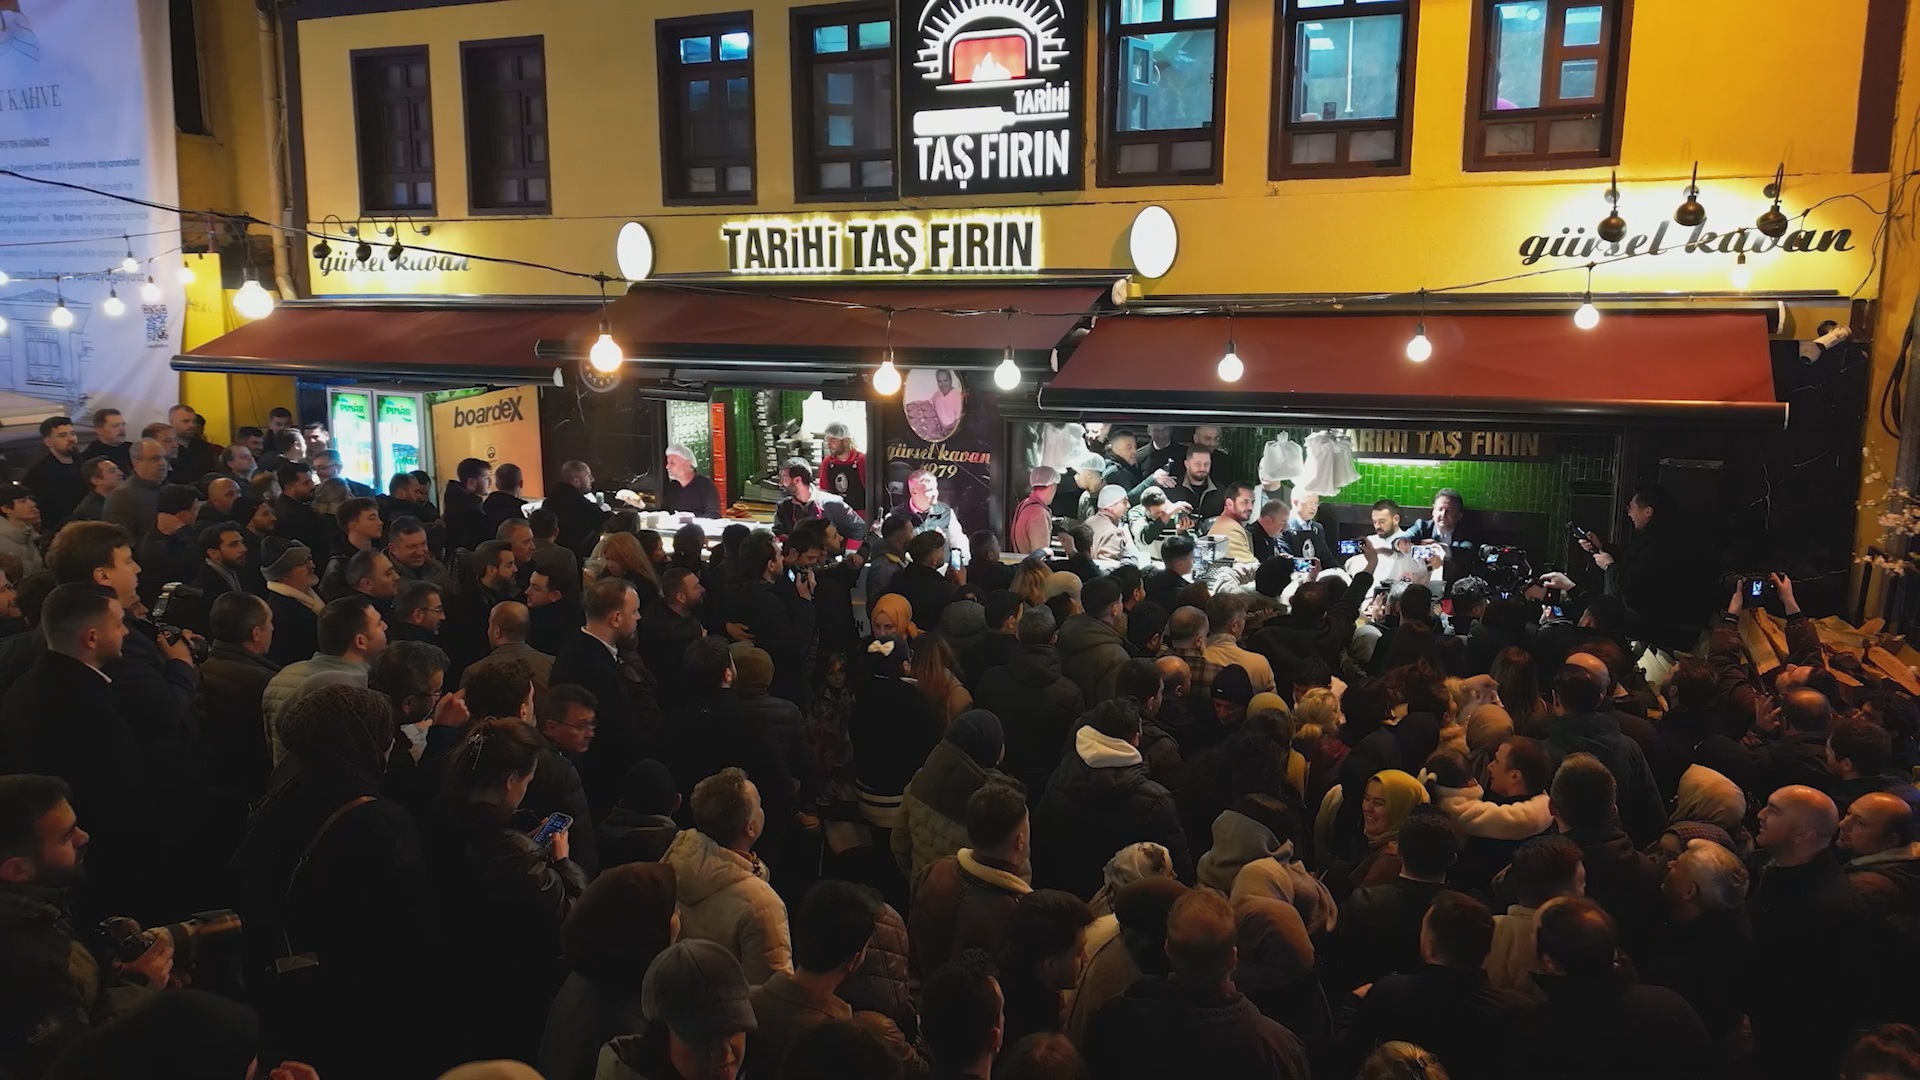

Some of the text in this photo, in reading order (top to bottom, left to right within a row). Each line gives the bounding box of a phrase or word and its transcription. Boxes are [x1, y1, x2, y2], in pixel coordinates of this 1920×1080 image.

[8, 84, 61, 110] KAHVE
[1013, 81, 1070, 114] TARİHİ
[913, 129, 1070, 189] TAŞ FIRIN
[848, 224, 916, 274] TAŞ
[931, 221, 1033, 267] FIRIN
[1518, 219, 1669, 266] gürsel
[1416, 430, 1463, 458] TAŞ
[1470, 431, 1540, 456] FIRIN
